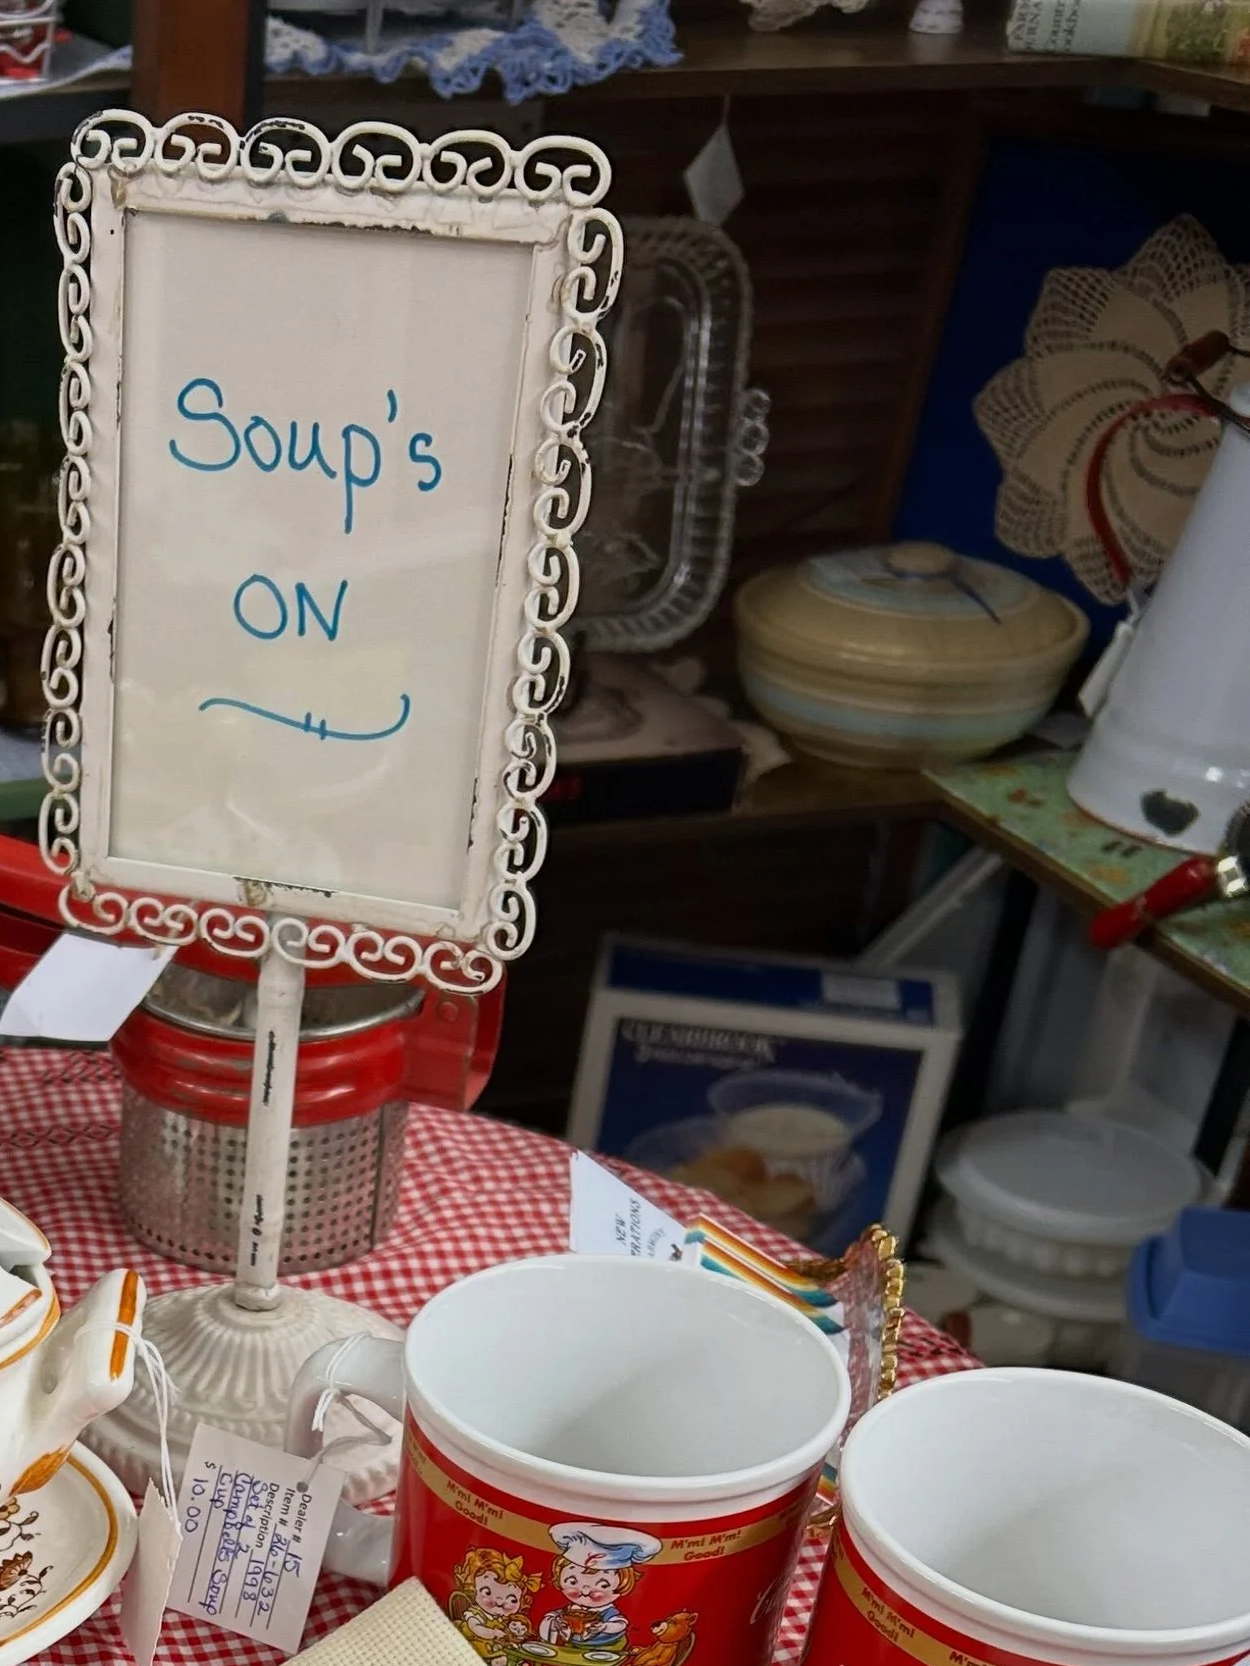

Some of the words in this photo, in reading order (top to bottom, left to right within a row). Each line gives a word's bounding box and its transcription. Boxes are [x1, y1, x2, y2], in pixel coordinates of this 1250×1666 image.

[168, 376, 443, 534] Soup's
[232, 572, 349, 643] ON
[184, 1477, 209, 1534] 10.00
[209, 1472, 233, 1509] Cup
[282, 1487, 296, 1516] Item
[254, 1482, 280, 1549] Description
[277, 1517, 289, 1527] #
[295, 1493, 313, 1533] Dealer
[455, 1500, 488, 1526] Good!
[291, 1533, 302, 1544] #
[683, 1546, 725, 1561] Good!
[242, 1559, 265, 1602] 1998
[283, 1551, 303, 1579] 15
[198, 1568, 229, 1616] Soup
